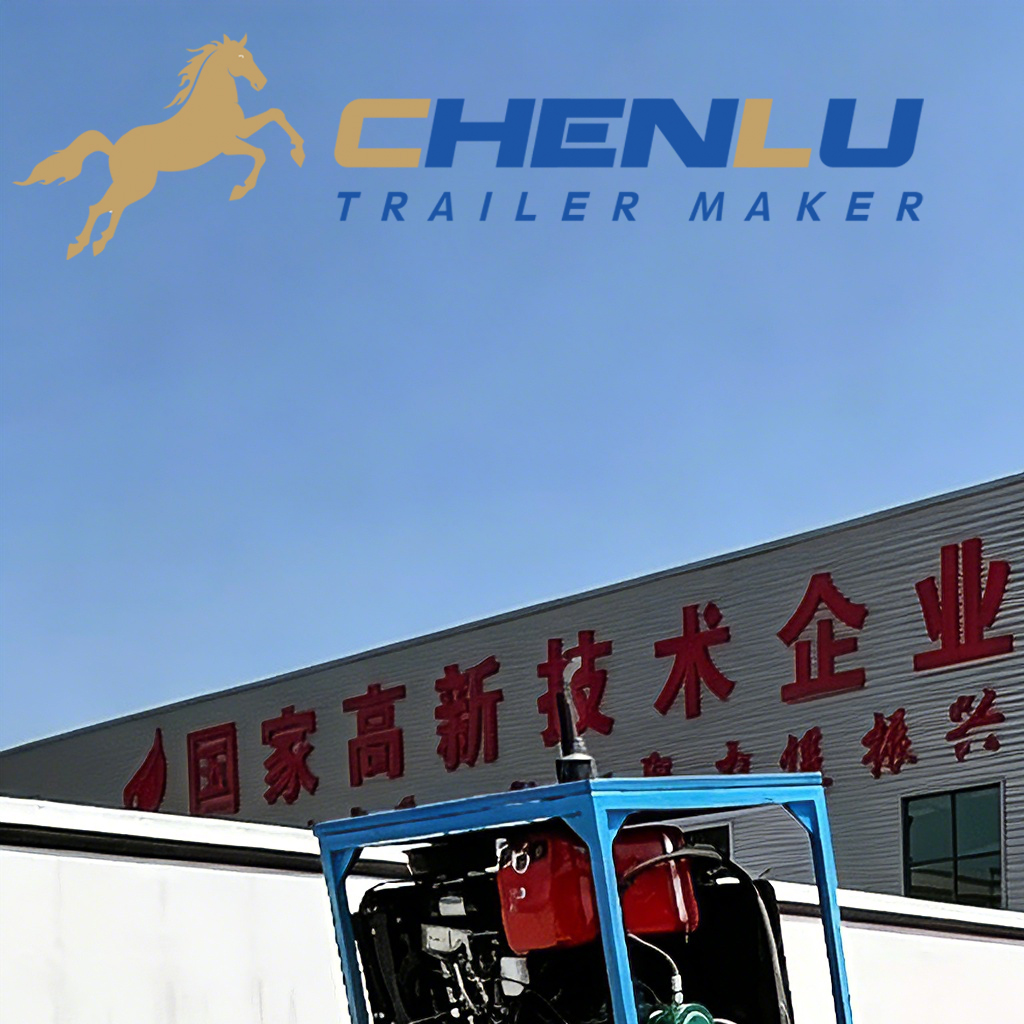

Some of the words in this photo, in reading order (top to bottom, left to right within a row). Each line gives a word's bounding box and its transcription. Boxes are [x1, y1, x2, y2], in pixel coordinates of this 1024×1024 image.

[186, 537, 1014, 816] 国家高新技术企业
